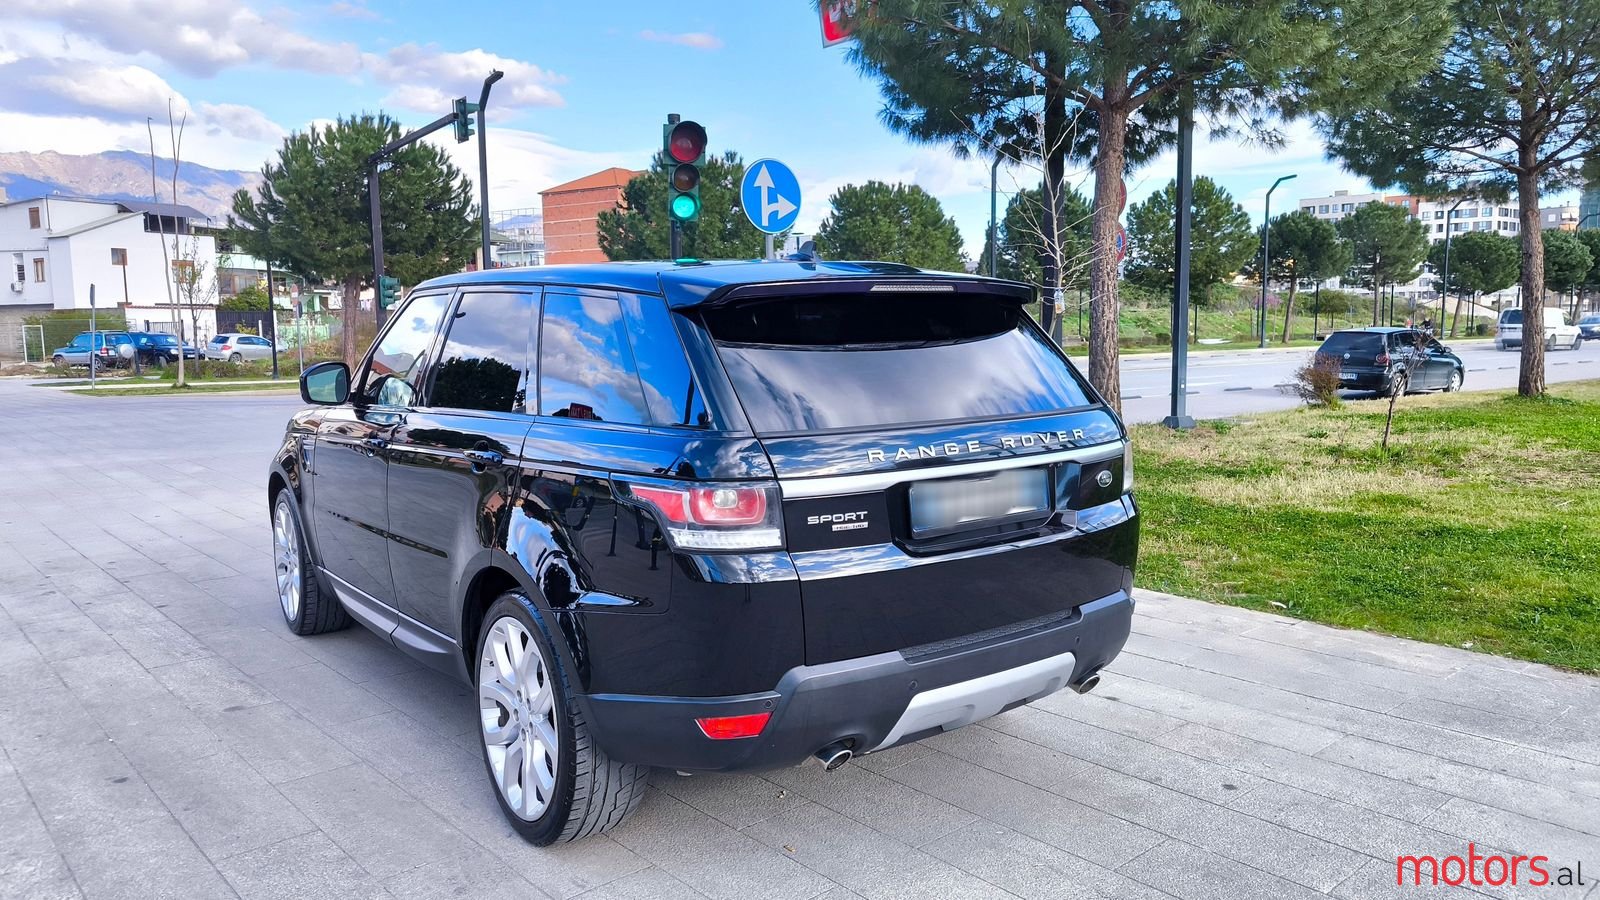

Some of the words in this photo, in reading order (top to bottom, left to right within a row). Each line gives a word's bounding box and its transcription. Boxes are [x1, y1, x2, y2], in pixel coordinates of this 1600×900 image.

[866, 440, 981, 463] RANGE
[1000, 428, 1085, 449] ROVER
[807, 511, 868, 525] SPORT
